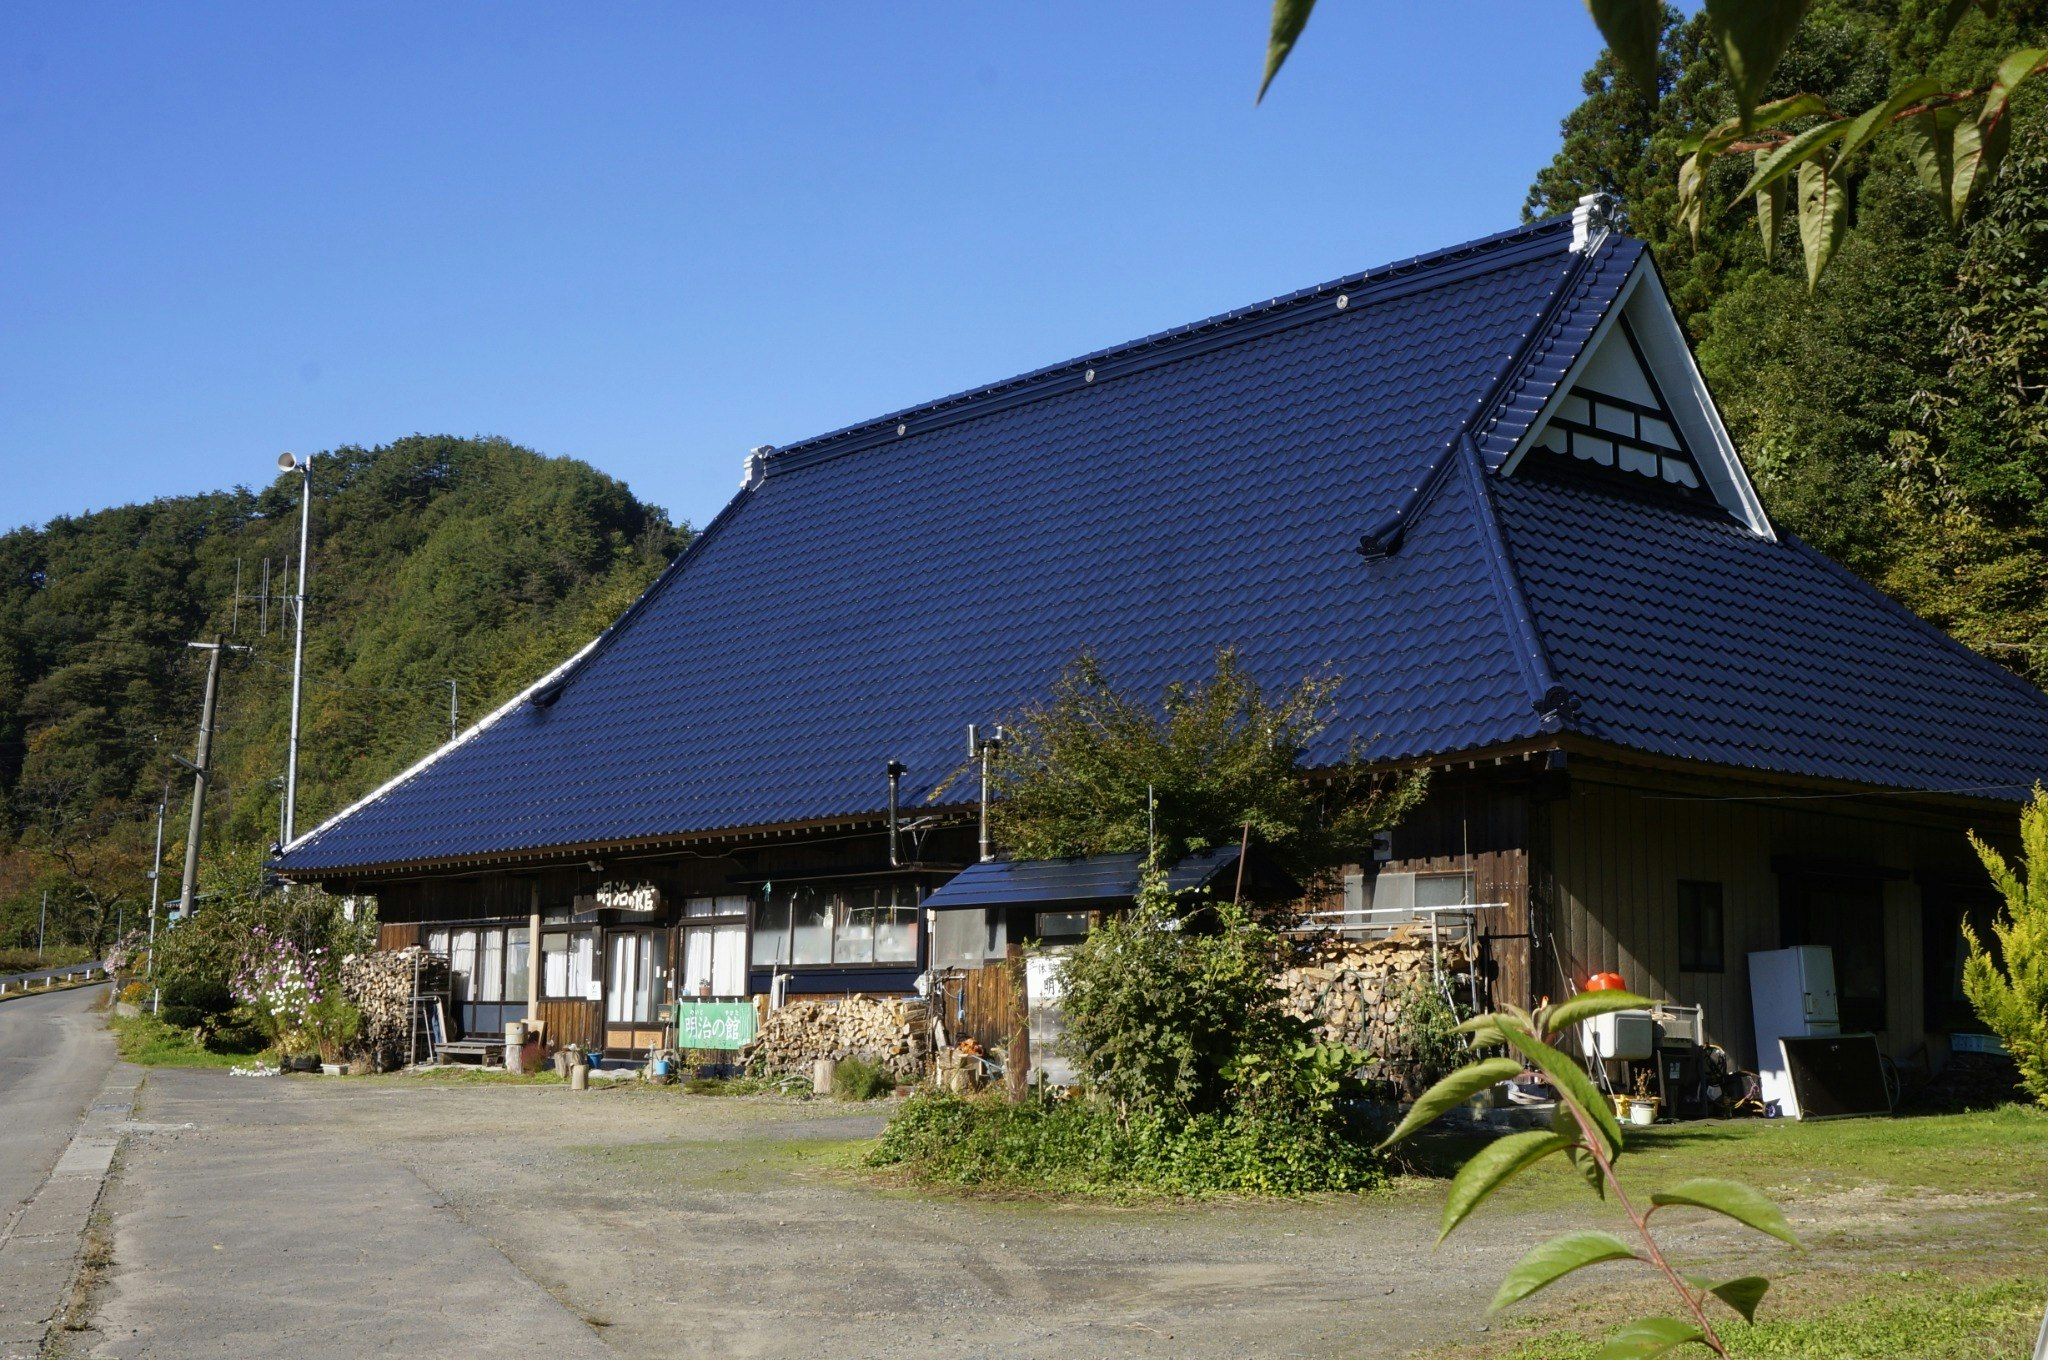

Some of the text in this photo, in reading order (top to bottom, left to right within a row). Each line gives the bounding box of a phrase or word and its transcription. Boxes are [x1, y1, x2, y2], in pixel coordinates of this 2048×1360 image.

[596, 880, 656, 911] 明治の館
[685, 1016, 741, 1041] 明治の館
